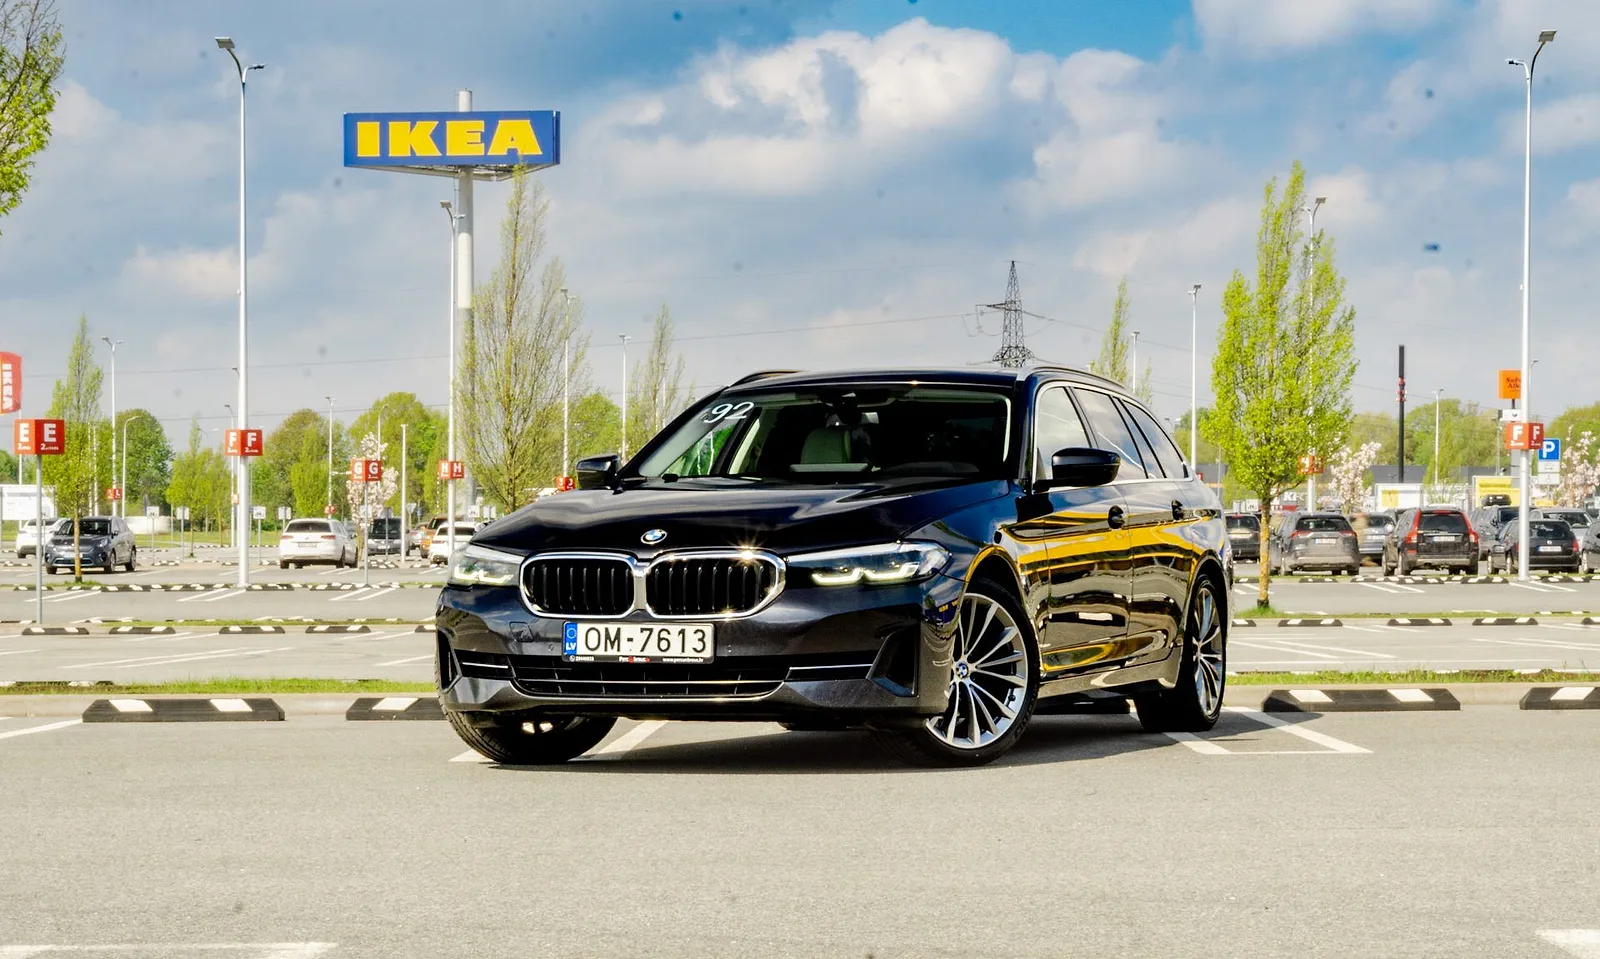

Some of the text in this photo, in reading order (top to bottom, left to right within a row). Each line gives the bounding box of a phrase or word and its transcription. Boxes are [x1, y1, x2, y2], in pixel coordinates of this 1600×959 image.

[357, 119, 543, 157] IKEA
[703, 401, 755, 423] 92
[19, 423, 30, 442] E
[43, 423, 57, 442] E
[229, 431, 237, 447] F
[247, 432, 257, 447] F
[1513, 425, 1523, 441] F
[1533, 425, 1541, 440] F
[1542, 441, 1556, 459] P
[368, 461, 379, 474] G
[453, 462, 462, 473] H
[565, 642, 577, 651] LV
[584, 627, 707, 653] OM-7613
